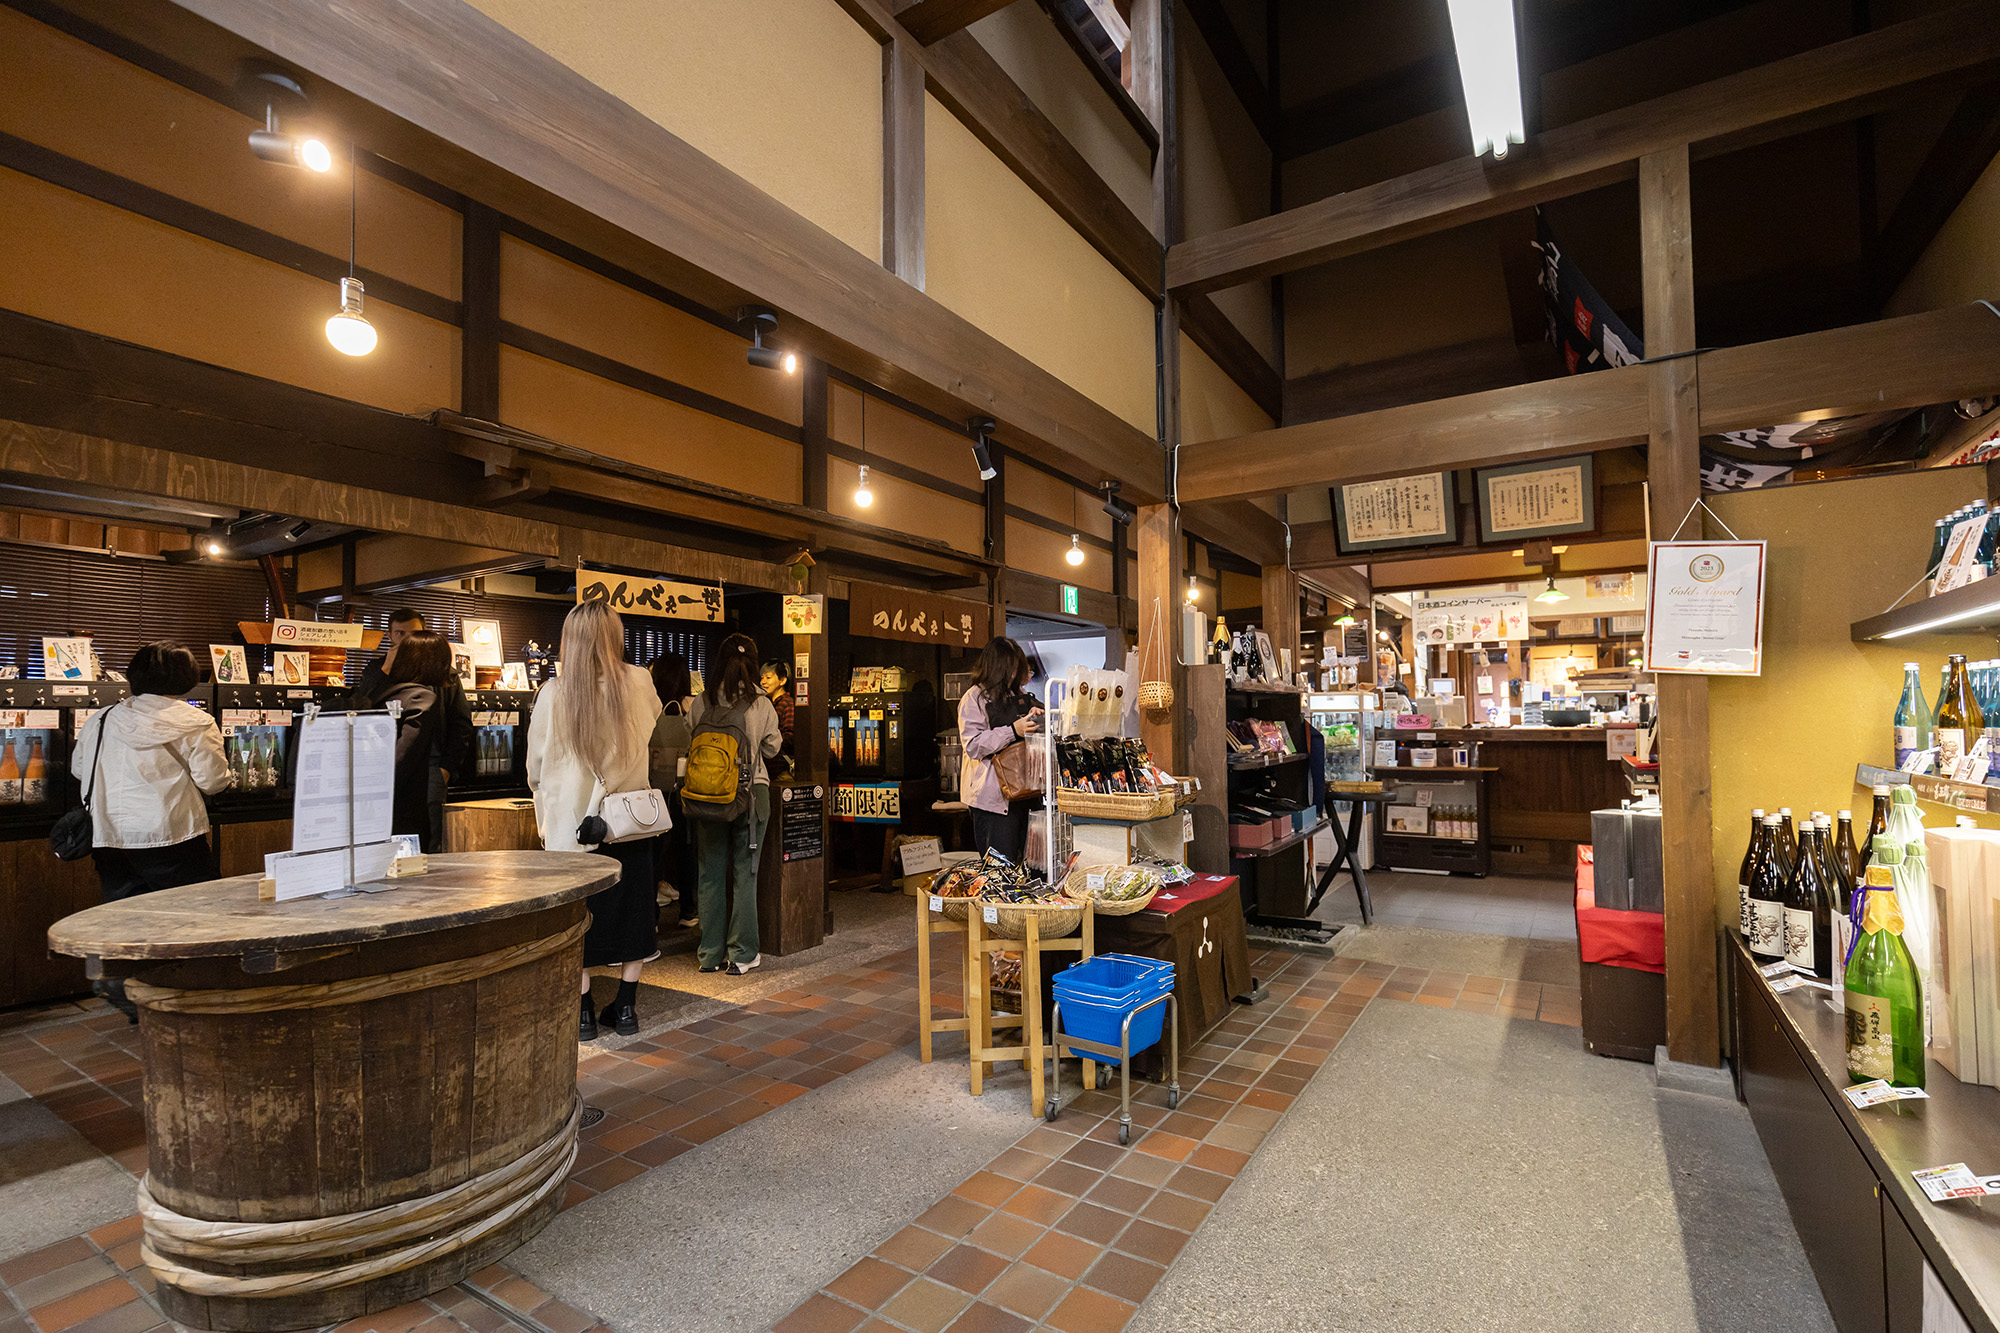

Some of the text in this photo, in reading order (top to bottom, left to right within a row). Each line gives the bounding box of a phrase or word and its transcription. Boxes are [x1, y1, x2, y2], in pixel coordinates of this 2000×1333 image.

[1668, 586, 1743, 596] Gold Award
[1418, 598, 1491, 610] 日本酒コインサーバー
[829, 789, 899, 816] 節限定
[1869, 1011, 1880, 1041] 飛騨高山
